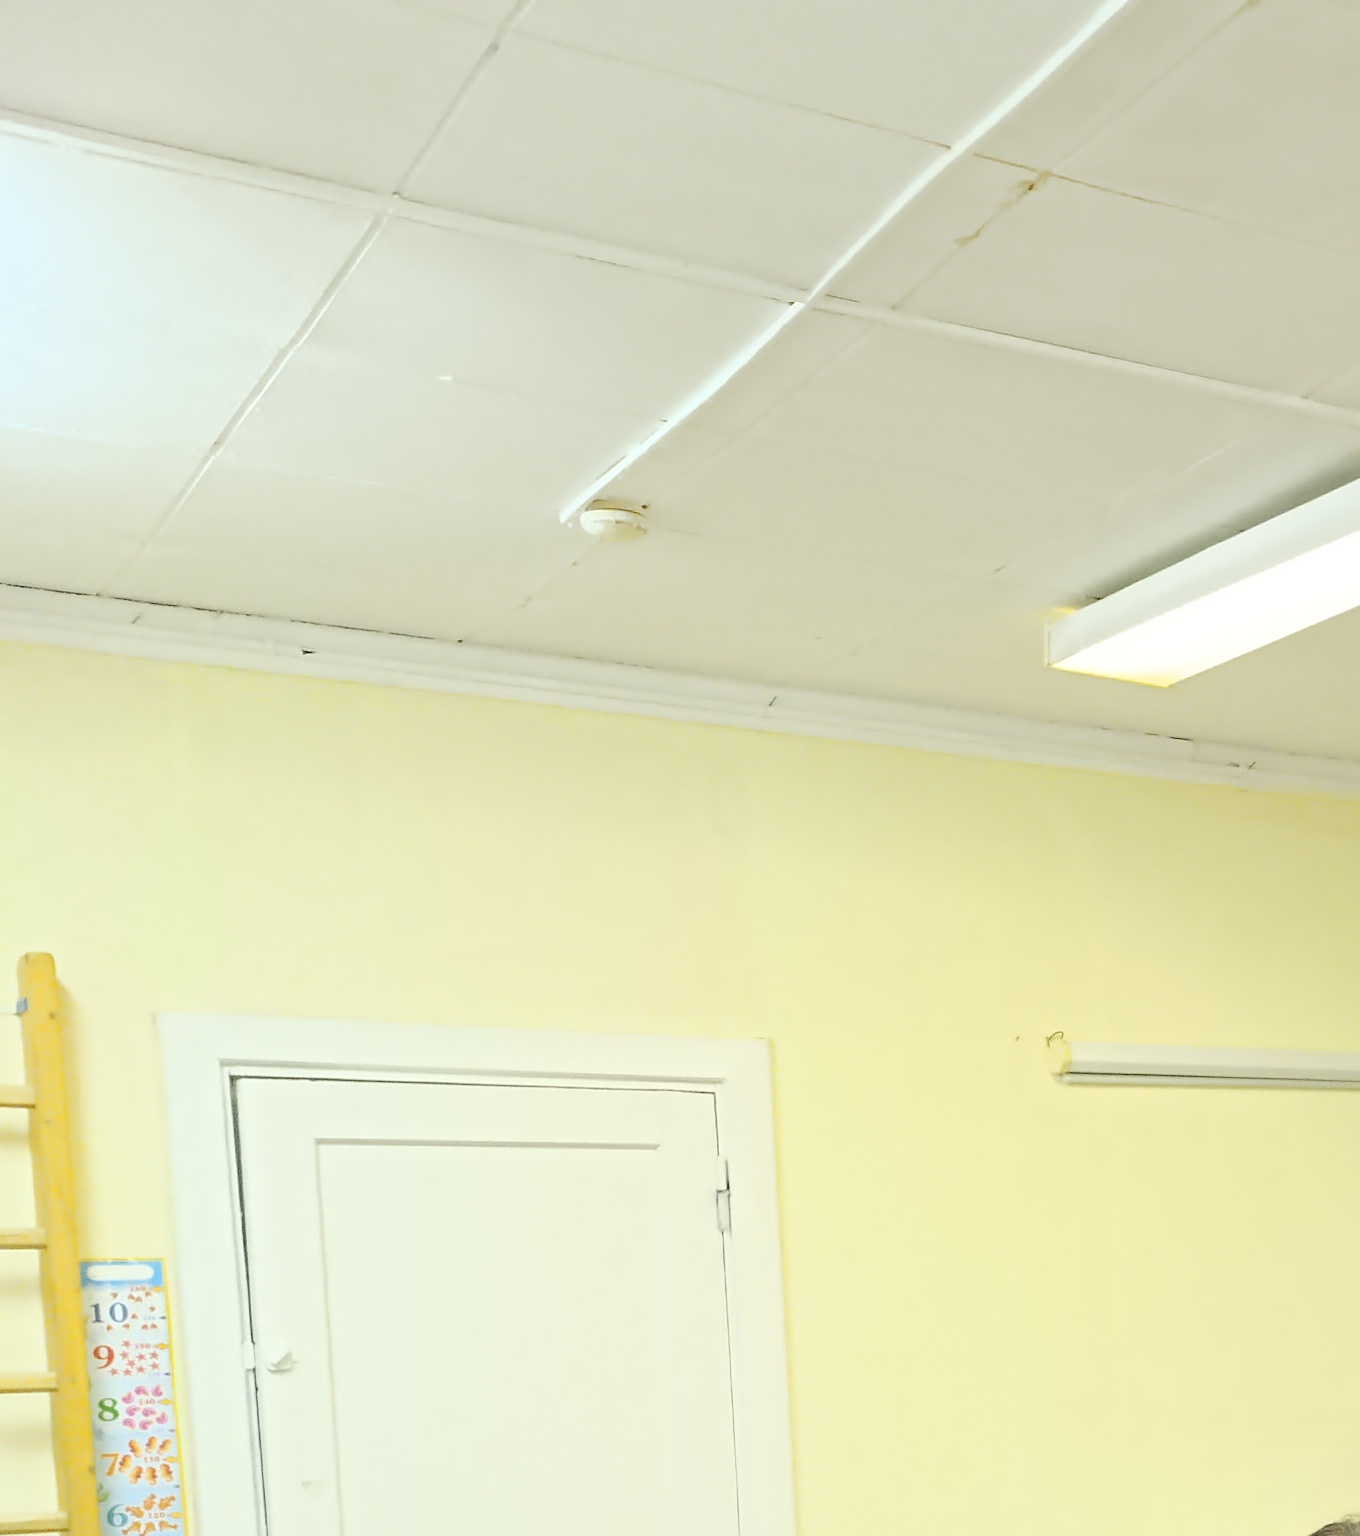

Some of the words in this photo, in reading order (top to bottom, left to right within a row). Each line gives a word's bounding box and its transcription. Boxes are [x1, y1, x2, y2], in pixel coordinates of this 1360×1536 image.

[91, 1301, 129, 1324] 10
[93, 1344, 115, 1369] 9
[97, 1397, 120, 1422] 8
[101, 1453, 120, 1477] 7
[106, 1503, 129, 1528] 6
